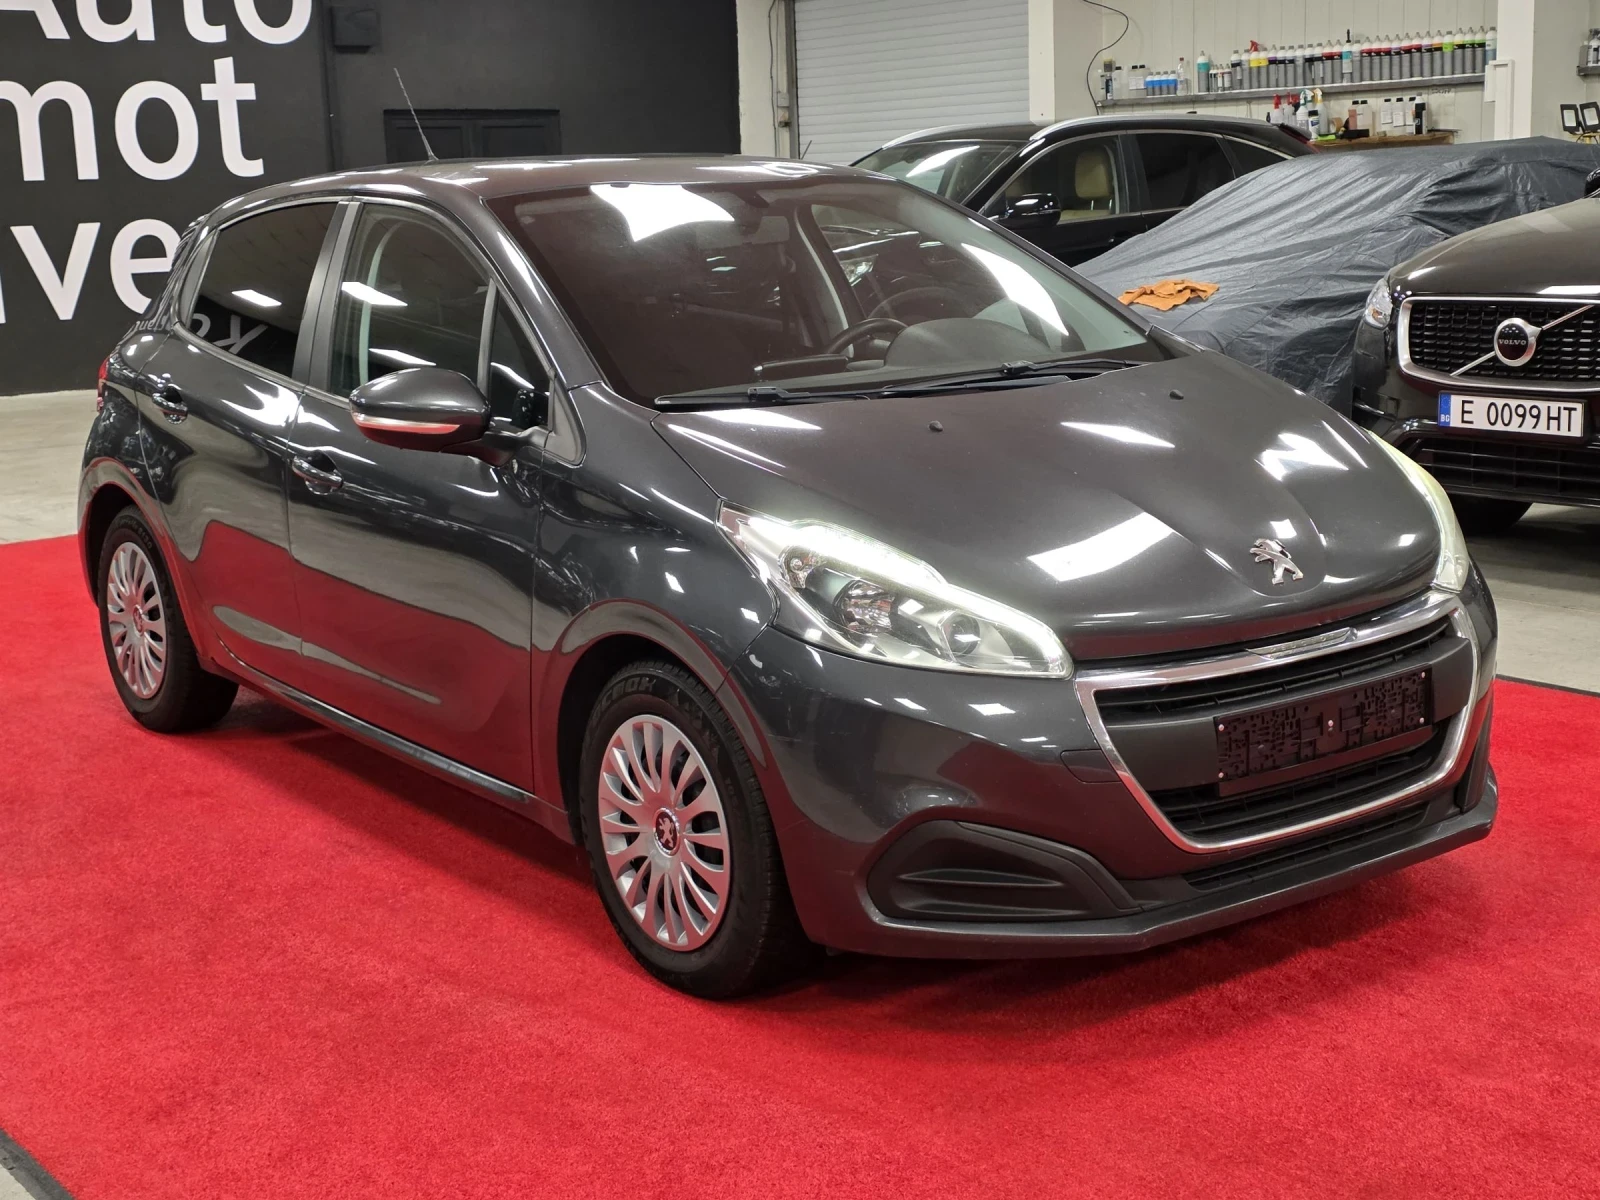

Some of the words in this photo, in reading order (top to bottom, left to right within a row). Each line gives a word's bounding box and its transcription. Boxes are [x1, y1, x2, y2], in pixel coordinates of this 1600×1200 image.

[0, 0, 312, 44] uo
[0, 57, 264, 181] mot
[0, 218, 181, 324] ve
[1440, 414, 1450, 422] BG
[1460, 400, 1474, 424] E
